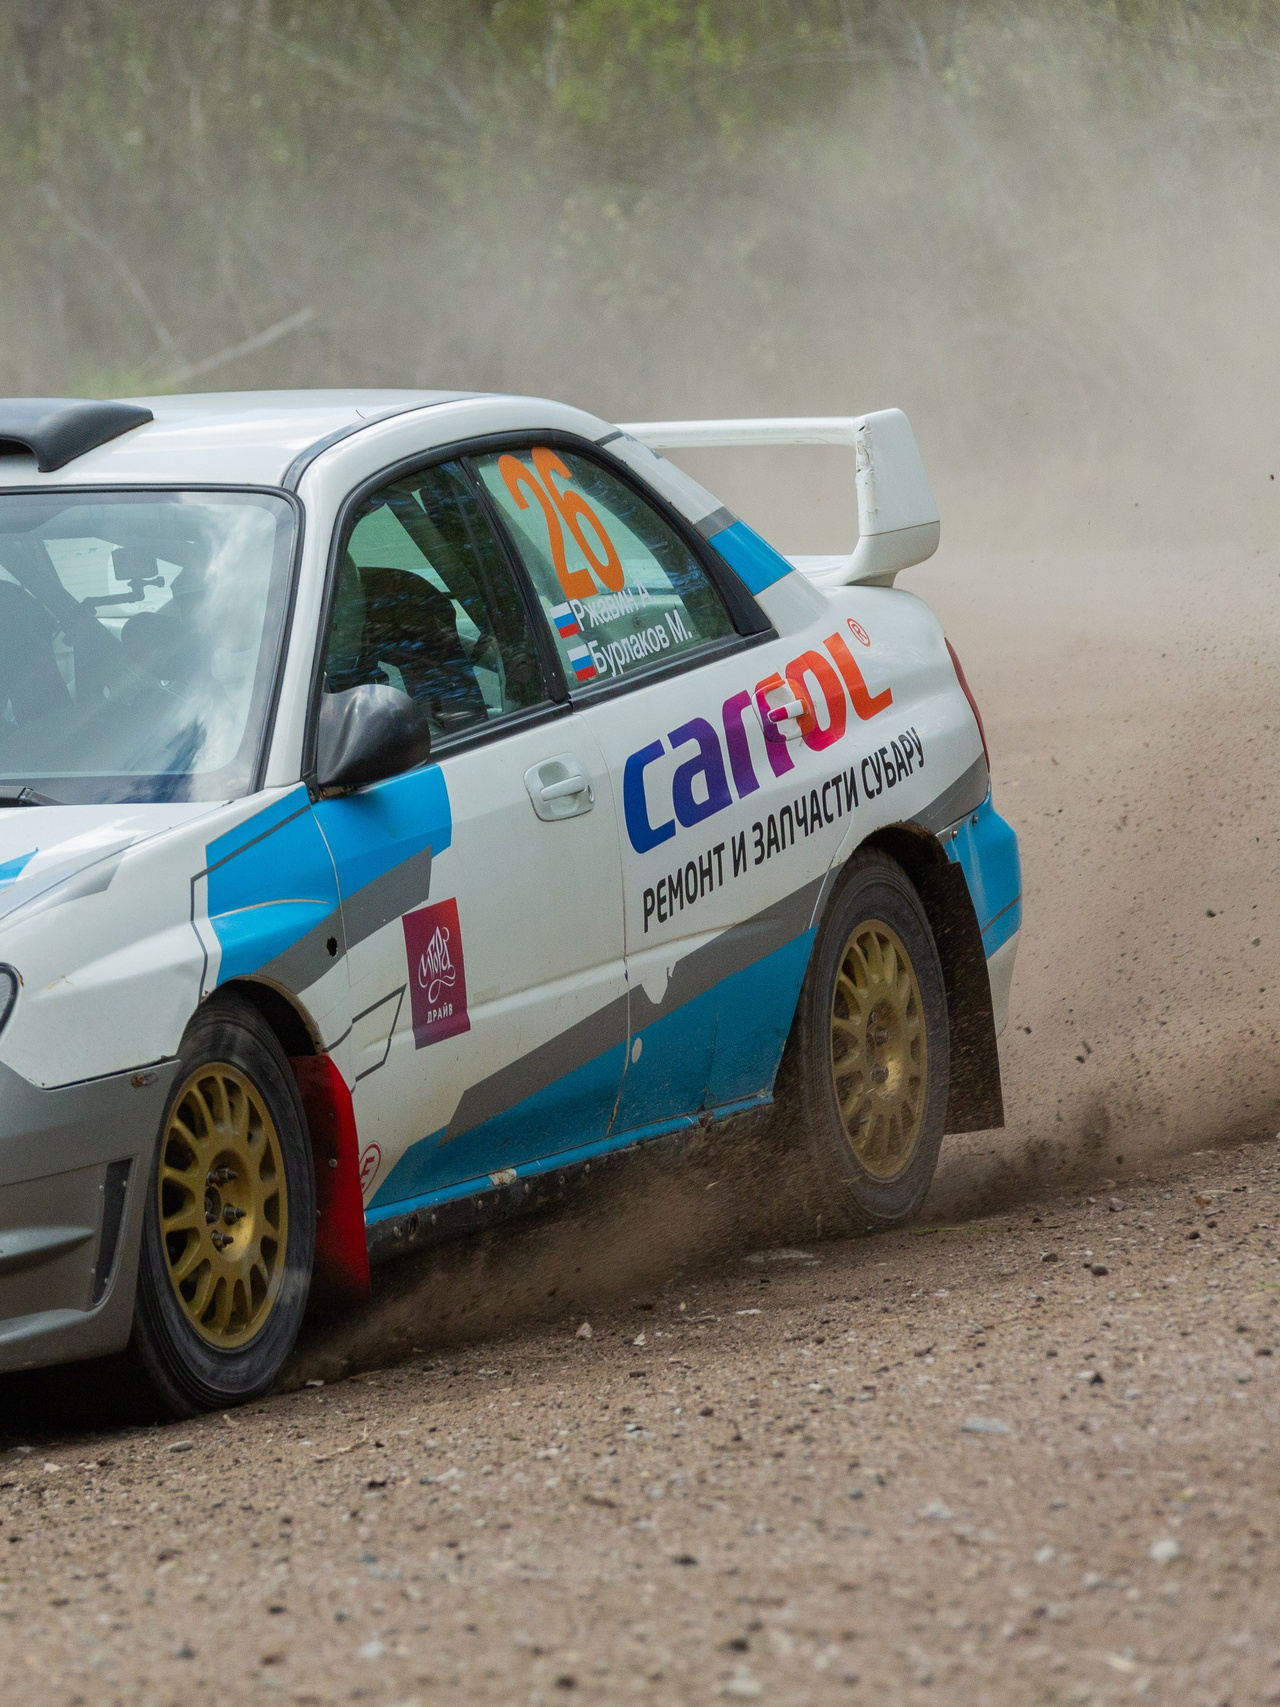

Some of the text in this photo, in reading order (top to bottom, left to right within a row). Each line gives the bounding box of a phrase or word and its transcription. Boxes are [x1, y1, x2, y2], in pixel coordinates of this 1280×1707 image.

[498, 446, 625, 600] 26
[570, 588, 634, 631] Ржавин
[588, 609, 693, 677] Бурлаков М.
[642, 726, 926, 934] РЕМОНТ И ЗАПЧАСТИ СУБАРУ
[427, 1003, 454, 1023] ДРАЙВ
